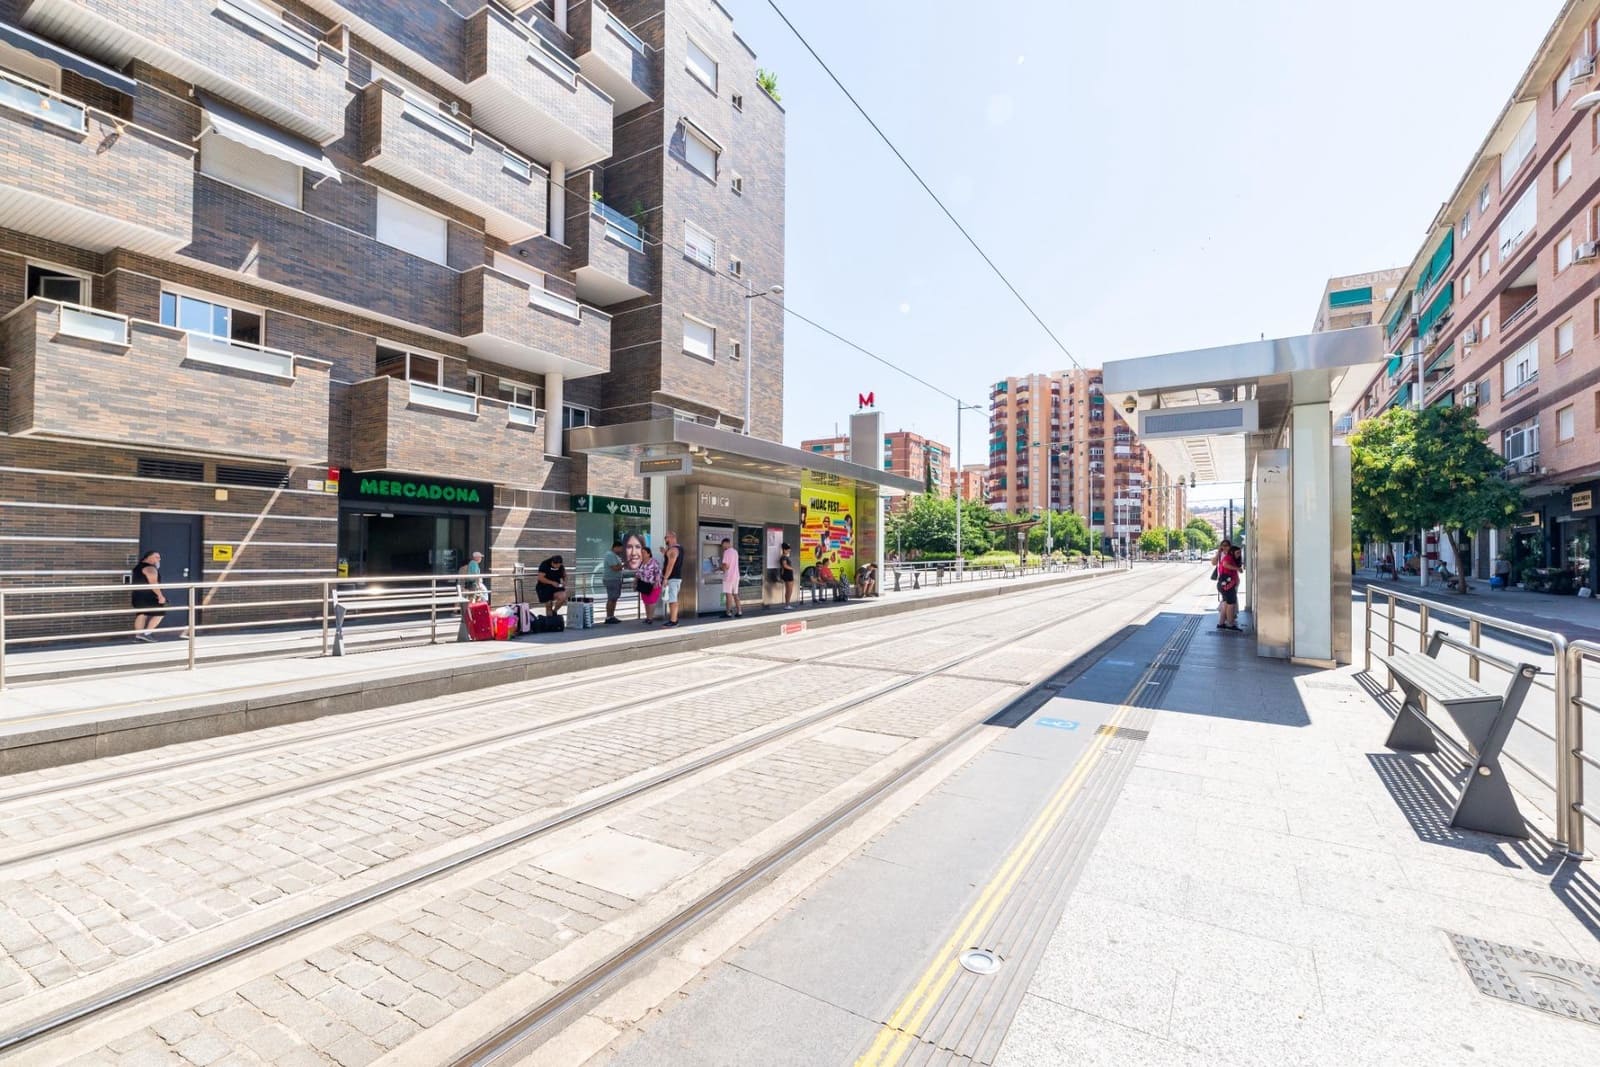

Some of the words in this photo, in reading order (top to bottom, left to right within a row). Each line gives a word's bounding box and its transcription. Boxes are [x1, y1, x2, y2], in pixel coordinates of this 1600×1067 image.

[859, 392, 874, 406] M
[360, 479, 480, 503] MERCADONA
[828, 500, 839, 512] FEST
